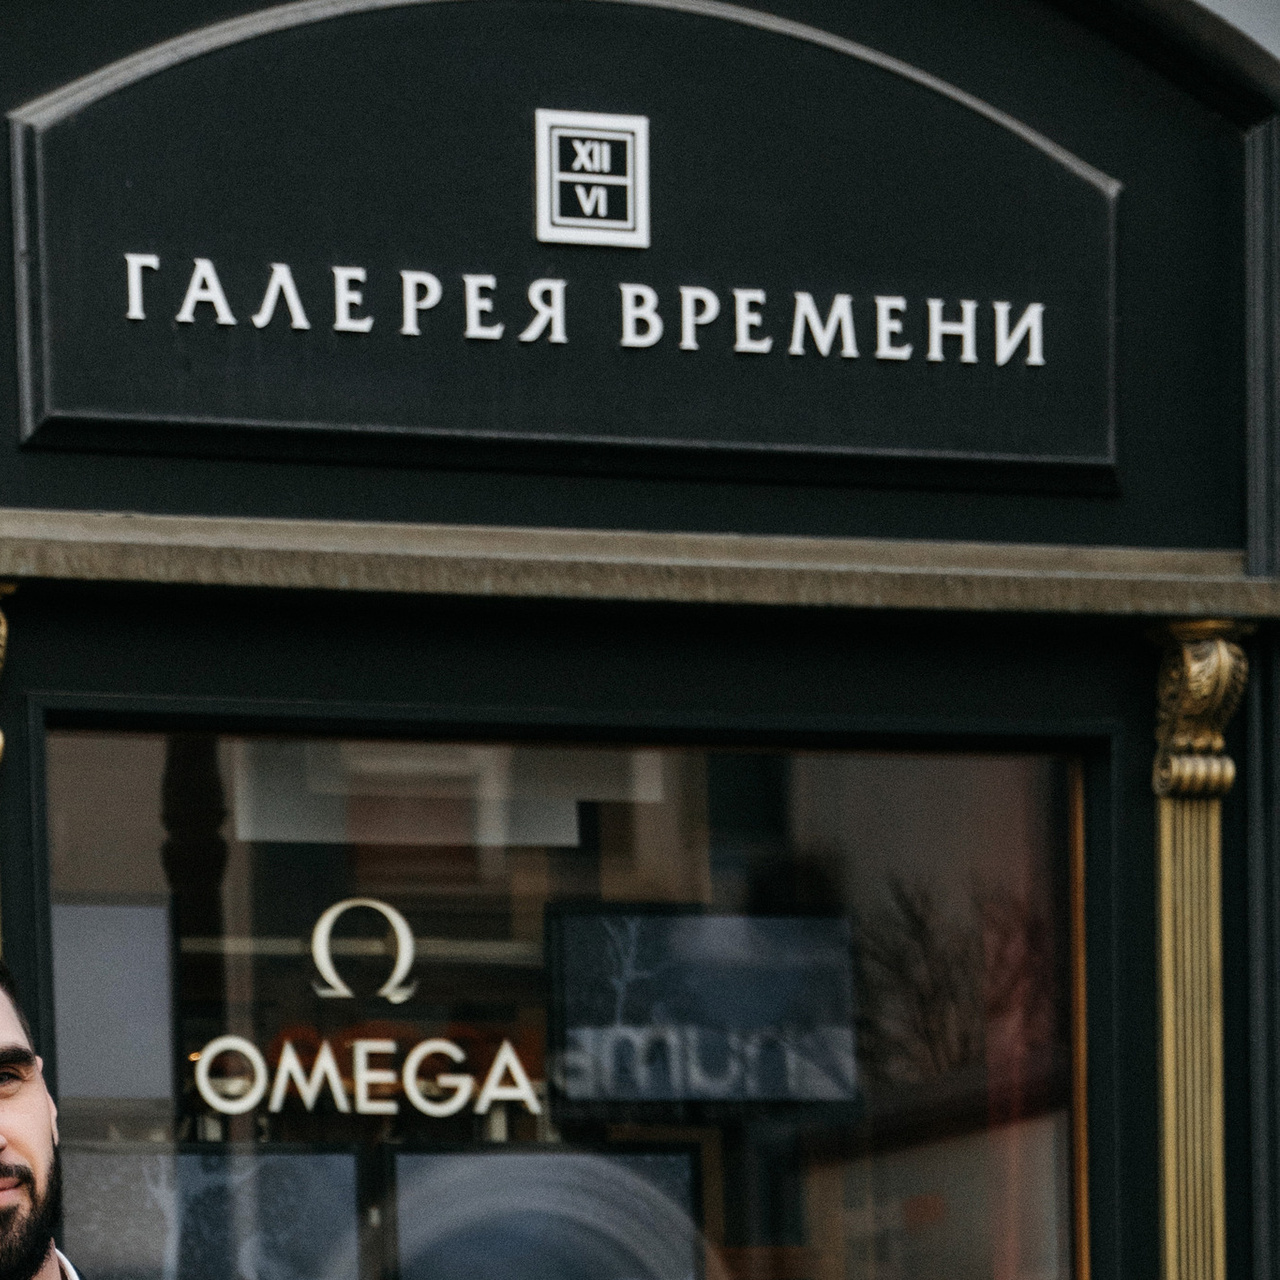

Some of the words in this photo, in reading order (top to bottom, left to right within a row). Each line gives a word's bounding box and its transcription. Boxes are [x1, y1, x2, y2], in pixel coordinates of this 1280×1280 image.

[571, 139, 611, 173] XII
[574, 184, 608, 218] VI
[124, 253, 567, 344] ГАЛЕРЕЯ
[619, 283, 1045, 366] ВРЕМЕНИ
[194, 1036, 541, 1116] OMEGA
